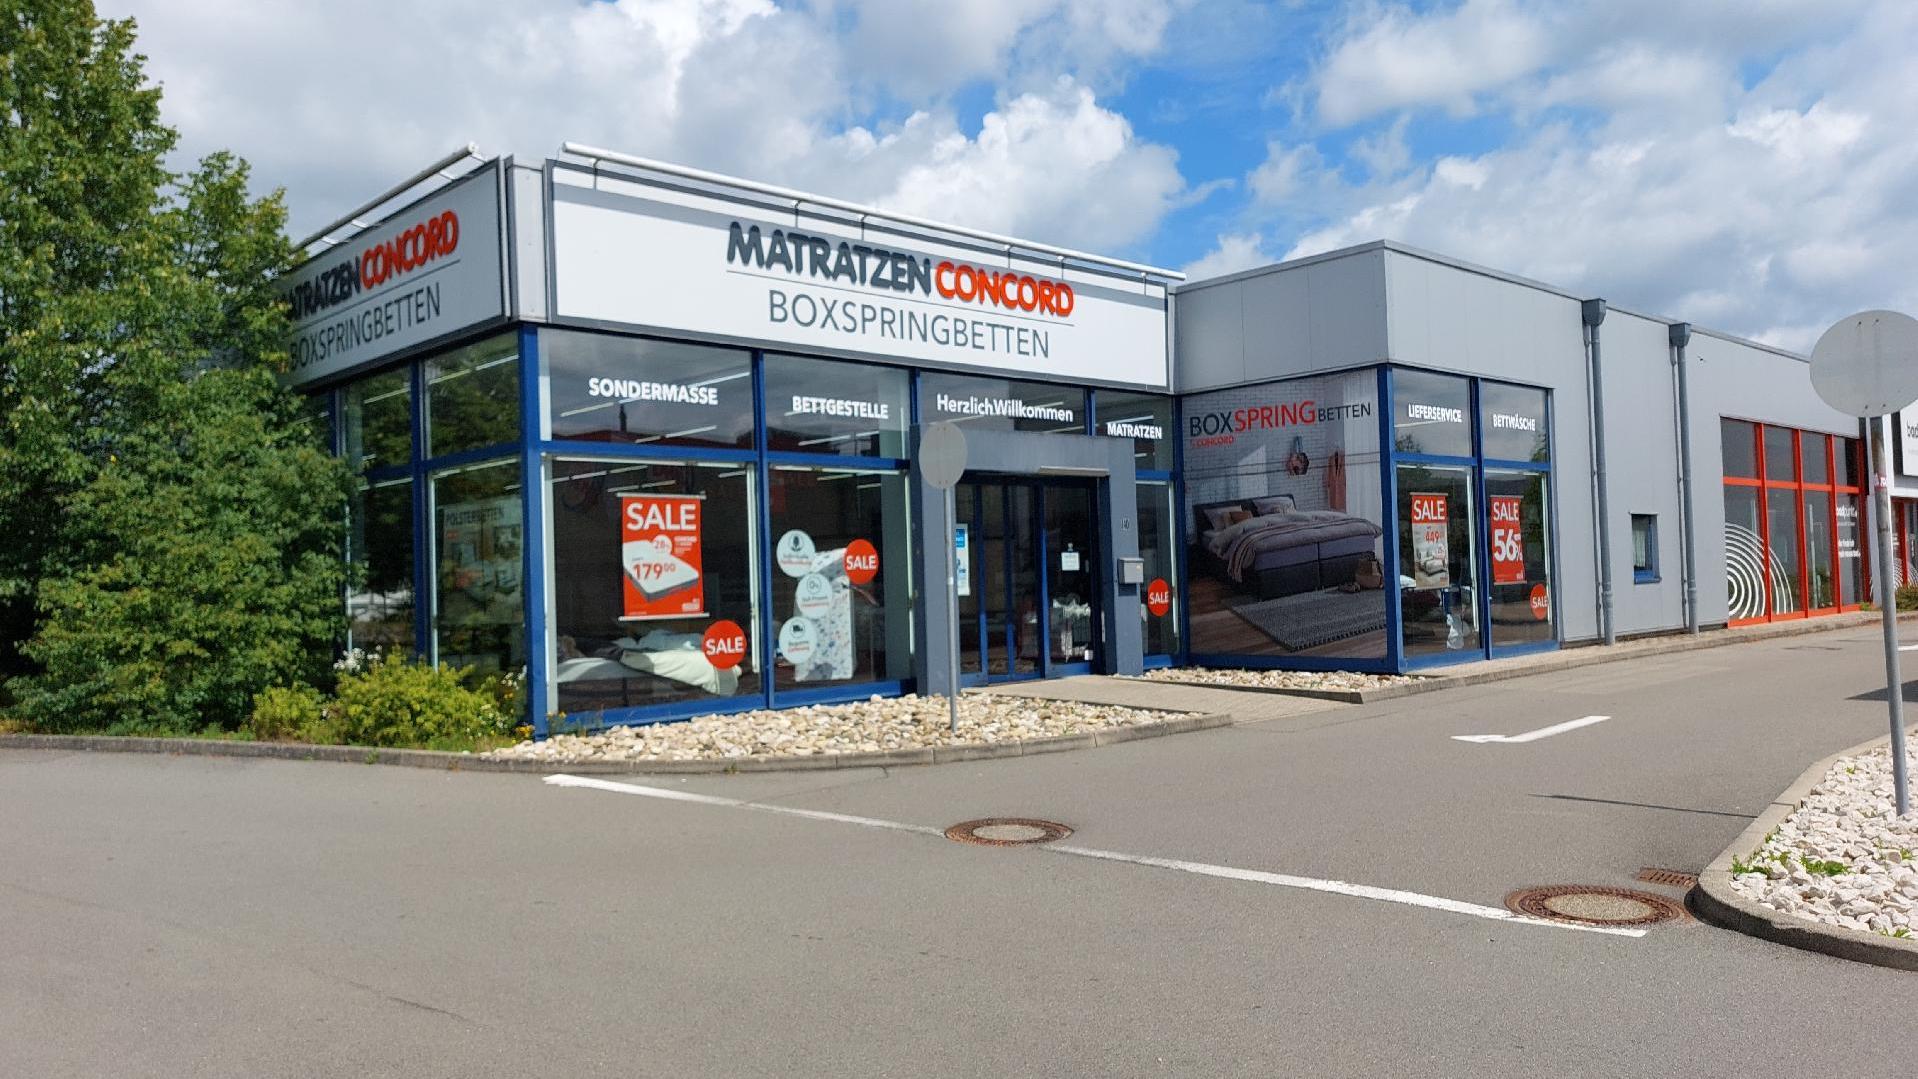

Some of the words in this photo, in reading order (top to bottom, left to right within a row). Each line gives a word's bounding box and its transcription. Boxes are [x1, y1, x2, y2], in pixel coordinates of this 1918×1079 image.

[360, 210, 460, 290] CONCORD
[769, 289, 1050, 358] BOXSPRINGBETTEN
[588, 377, 719, 406] SONDERMASSE
[792, 395, 889, 419] BETTGESTELLE
[1408, 403, 1463, 423] LIEFERSERVICE
[1107, 422, 1163, 440] MATRATZEN
[1493, 413, 1536, 431] BETTWÄSCHE
[626, 502, 697, 531] SALE
[1413, 500, 1446, 520] SALE
[1493, 501, 1519, 521] SALE
[846, 555, 876, 570] SALE
[1149, 591, 1169, 605] SALE
[1532, 597, 1548, 609] SALE
[705, 636, 744, 654] SALE
